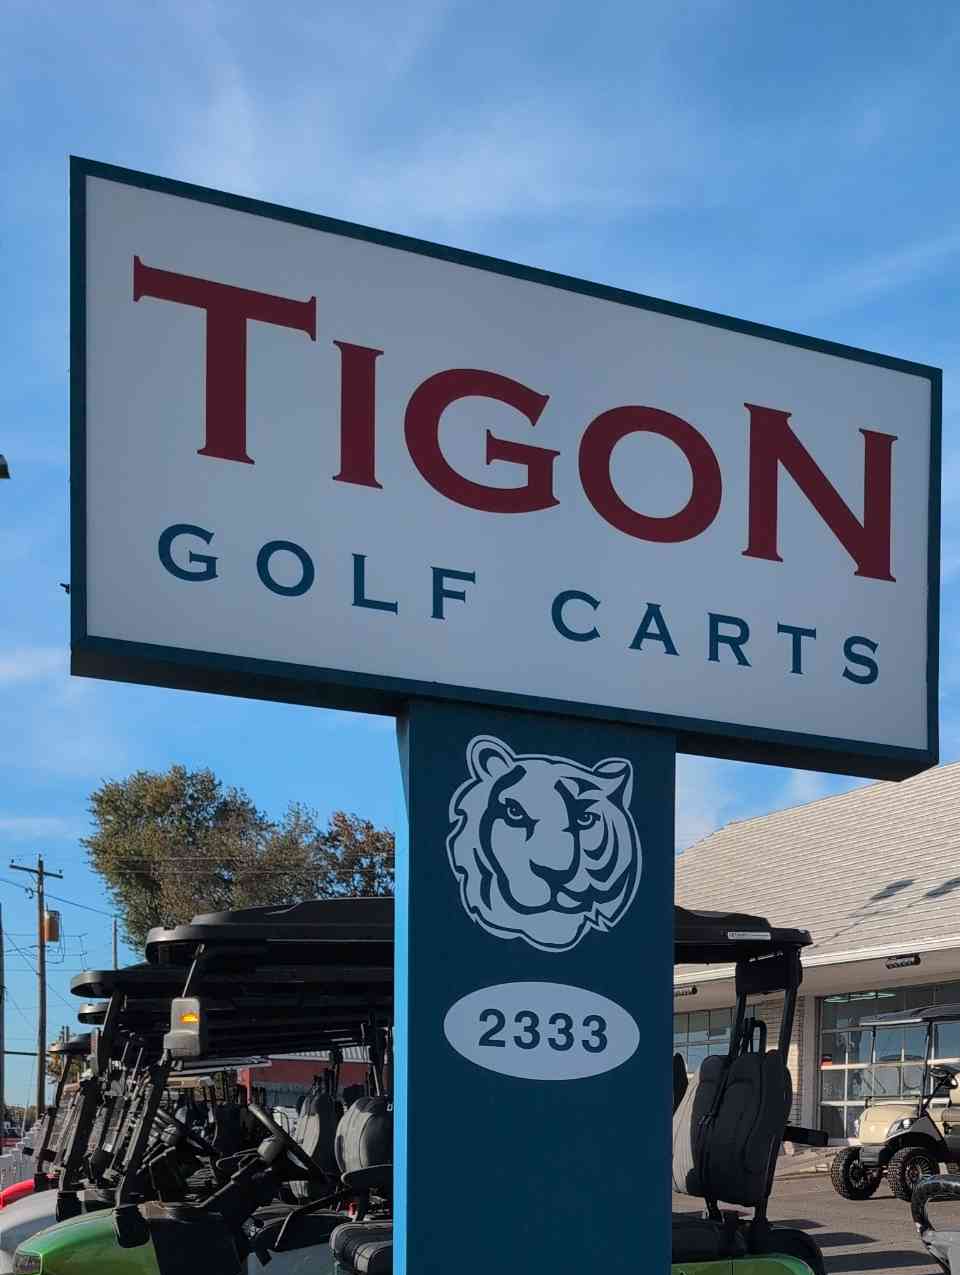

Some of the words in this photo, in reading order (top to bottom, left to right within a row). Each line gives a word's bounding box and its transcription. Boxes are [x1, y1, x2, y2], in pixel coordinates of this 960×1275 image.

[133, 255, 898, 582] TIGON
[157, 523, 476, 621] GOLF
[551, 590, 881, 685] CARTS
[478, 1008, 608, 1054] 2333
